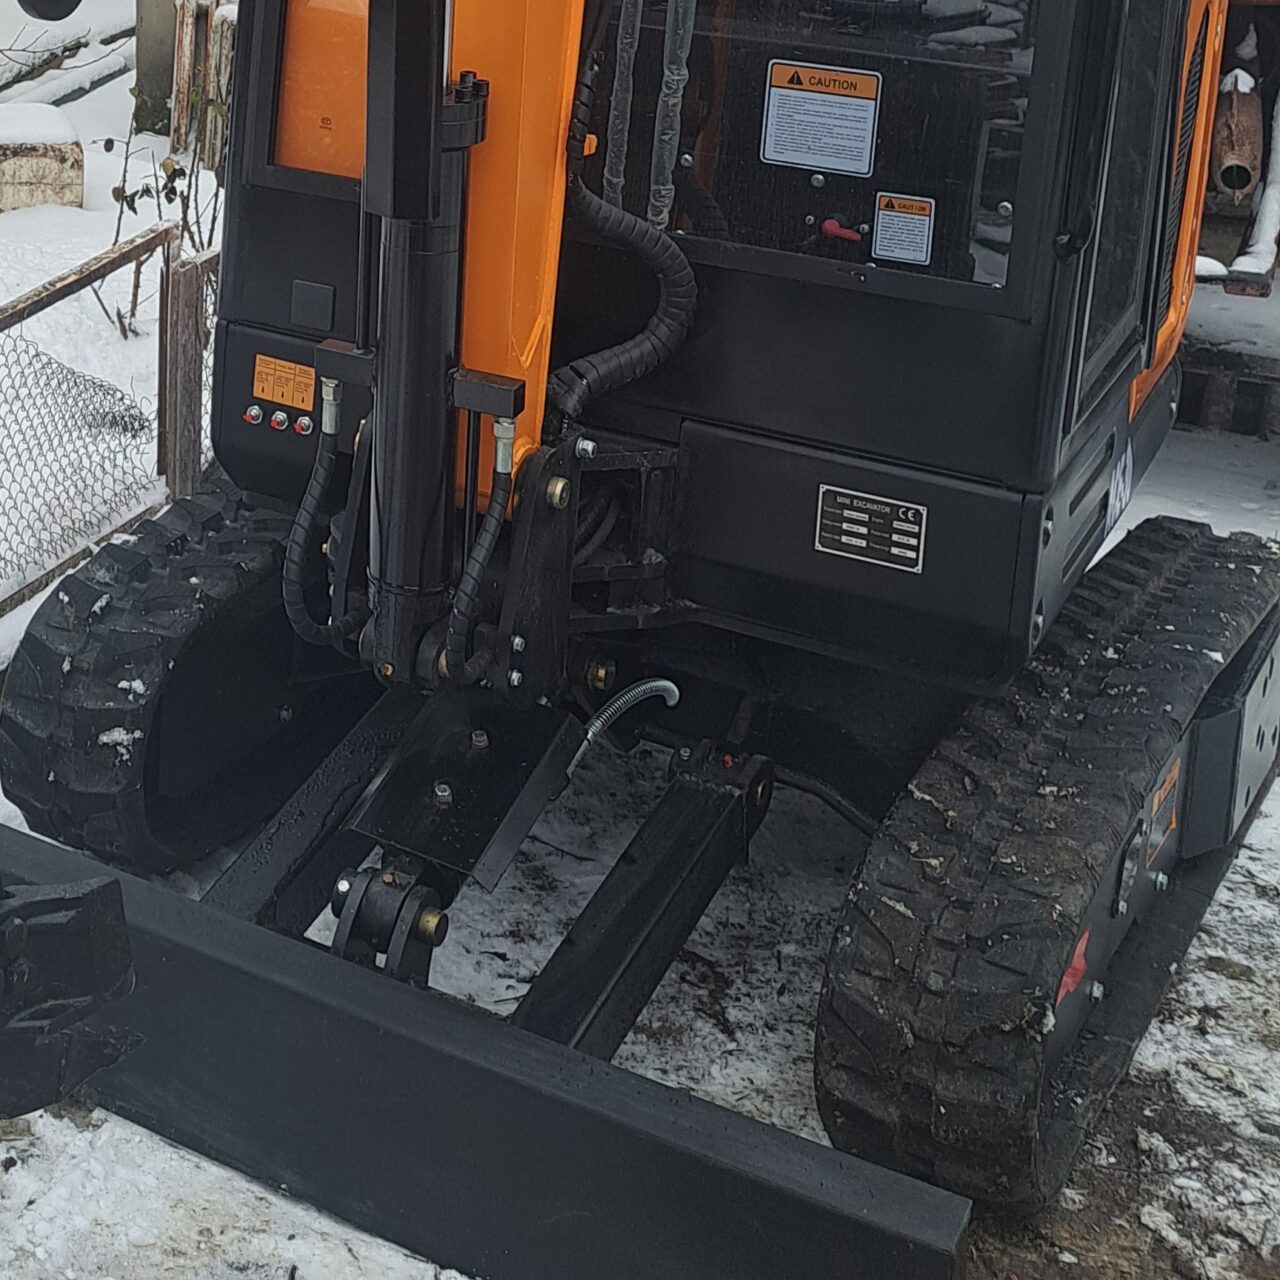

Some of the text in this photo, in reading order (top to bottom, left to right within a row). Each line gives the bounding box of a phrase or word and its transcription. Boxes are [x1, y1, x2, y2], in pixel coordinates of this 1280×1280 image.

[808, 76, 857, 92] CAUTION
[897, 202, 927, 212] CAUTION
[836, 495, 851, 504] MINI
[853, 500, 891, 514] EXCAVATOR
